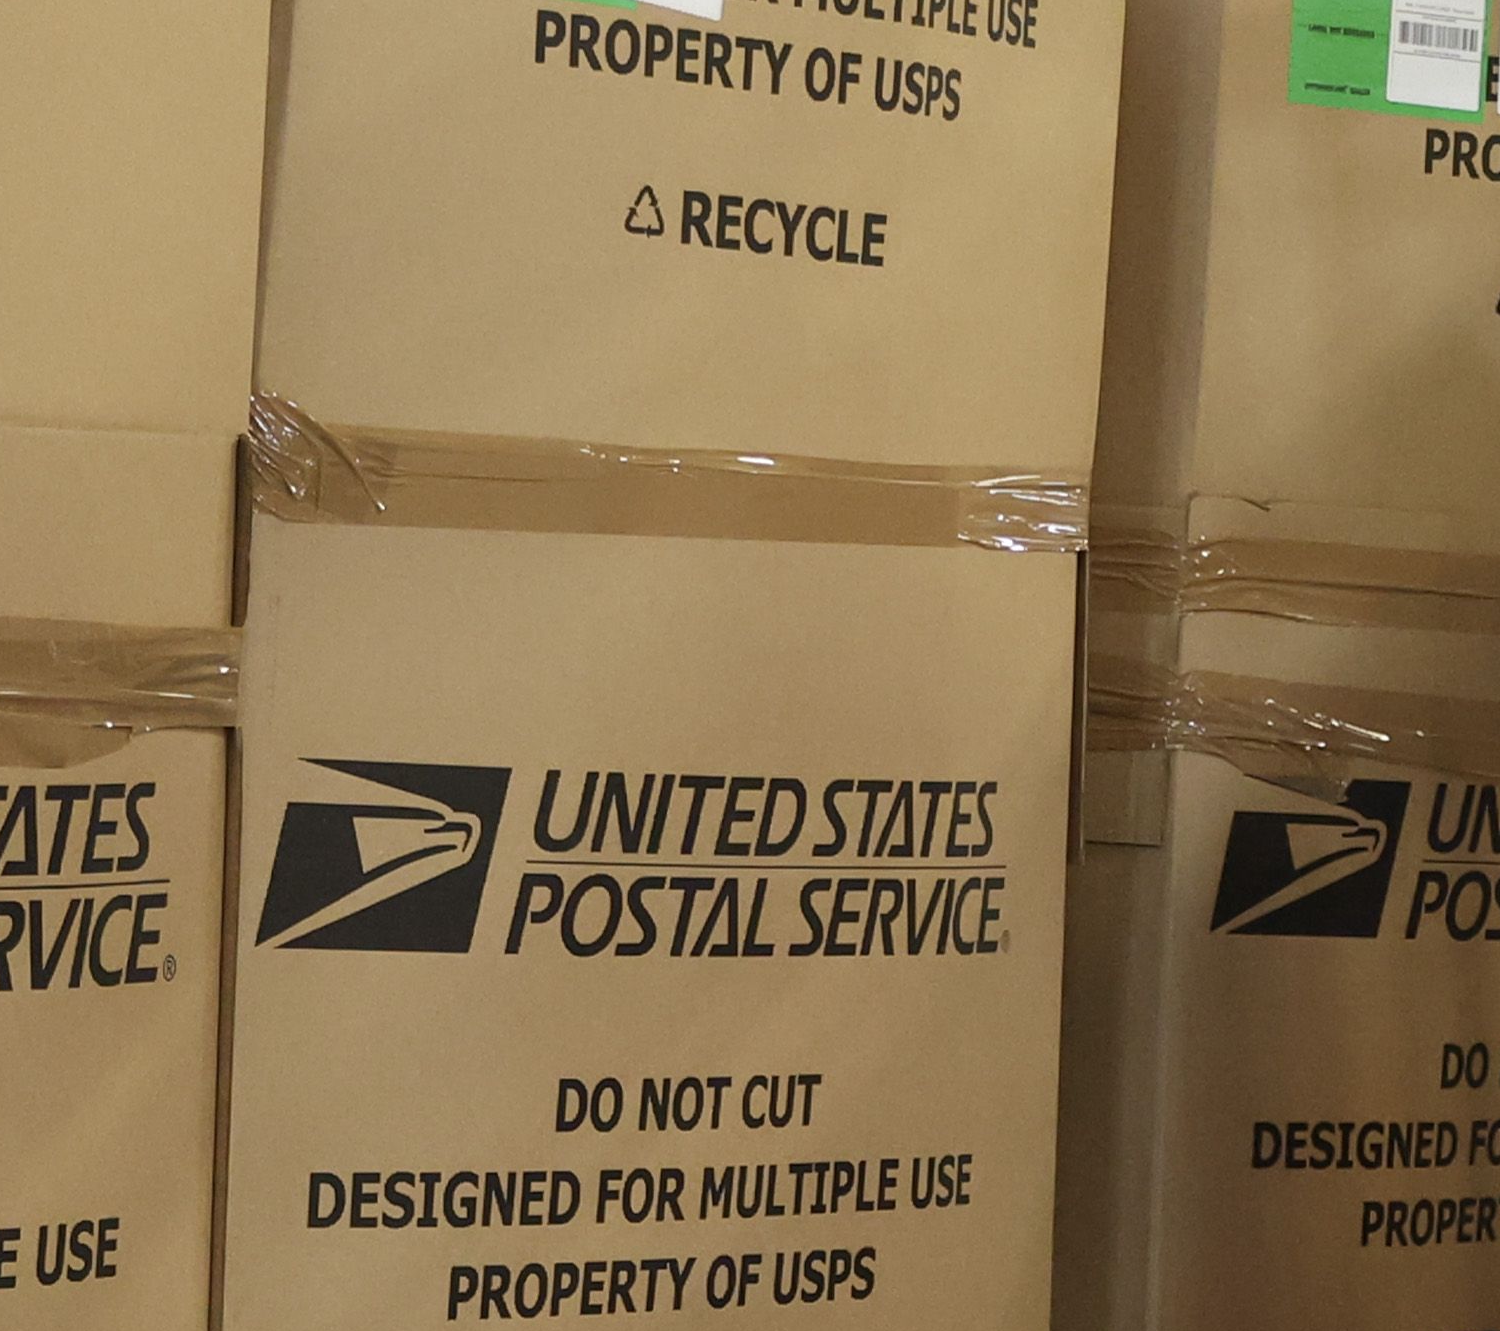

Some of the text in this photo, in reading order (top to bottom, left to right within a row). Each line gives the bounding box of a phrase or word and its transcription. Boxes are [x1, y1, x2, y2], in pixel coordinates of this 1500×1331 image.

[533, 11, 962, 122] PROPERTY OF USPS
[680, 189, 888, 268] RECYCLE
[532, 769, 999, 858] UNITED STATES
[504, 873, 775, 958] POSTAL
[556, 1074, 822, 1133] DO NOT CUT
[307, 1155, 973, 1229] DESIGNED FOR MULTIPLE USE
[34, 1217, 120, 1286] USE
[448, 1247, 876, 1322] PROPERTY OF USPS
